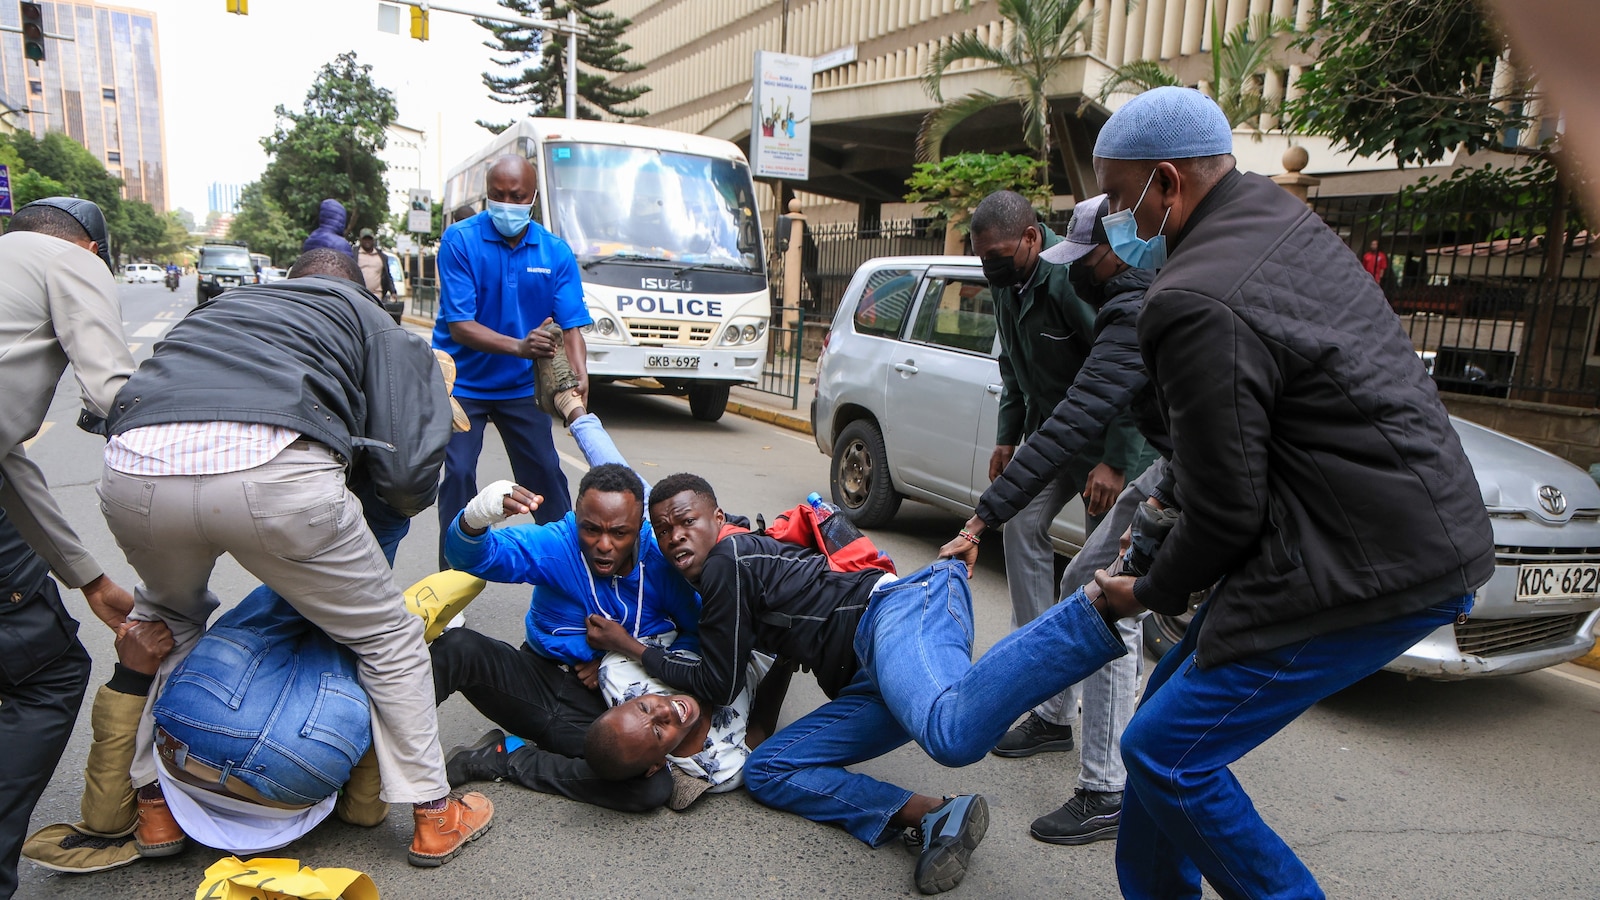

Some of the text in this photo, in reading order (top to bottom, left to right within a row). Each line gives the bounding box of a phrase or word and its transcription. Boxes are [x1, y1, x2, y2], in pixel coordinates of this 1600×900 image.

[641, 277, 693, 292] ISUZU
[616, 295, 723, 317] POLICE
[648, 356, 670, 367] GKB
[1519, 568, 1554, 595] KDC
